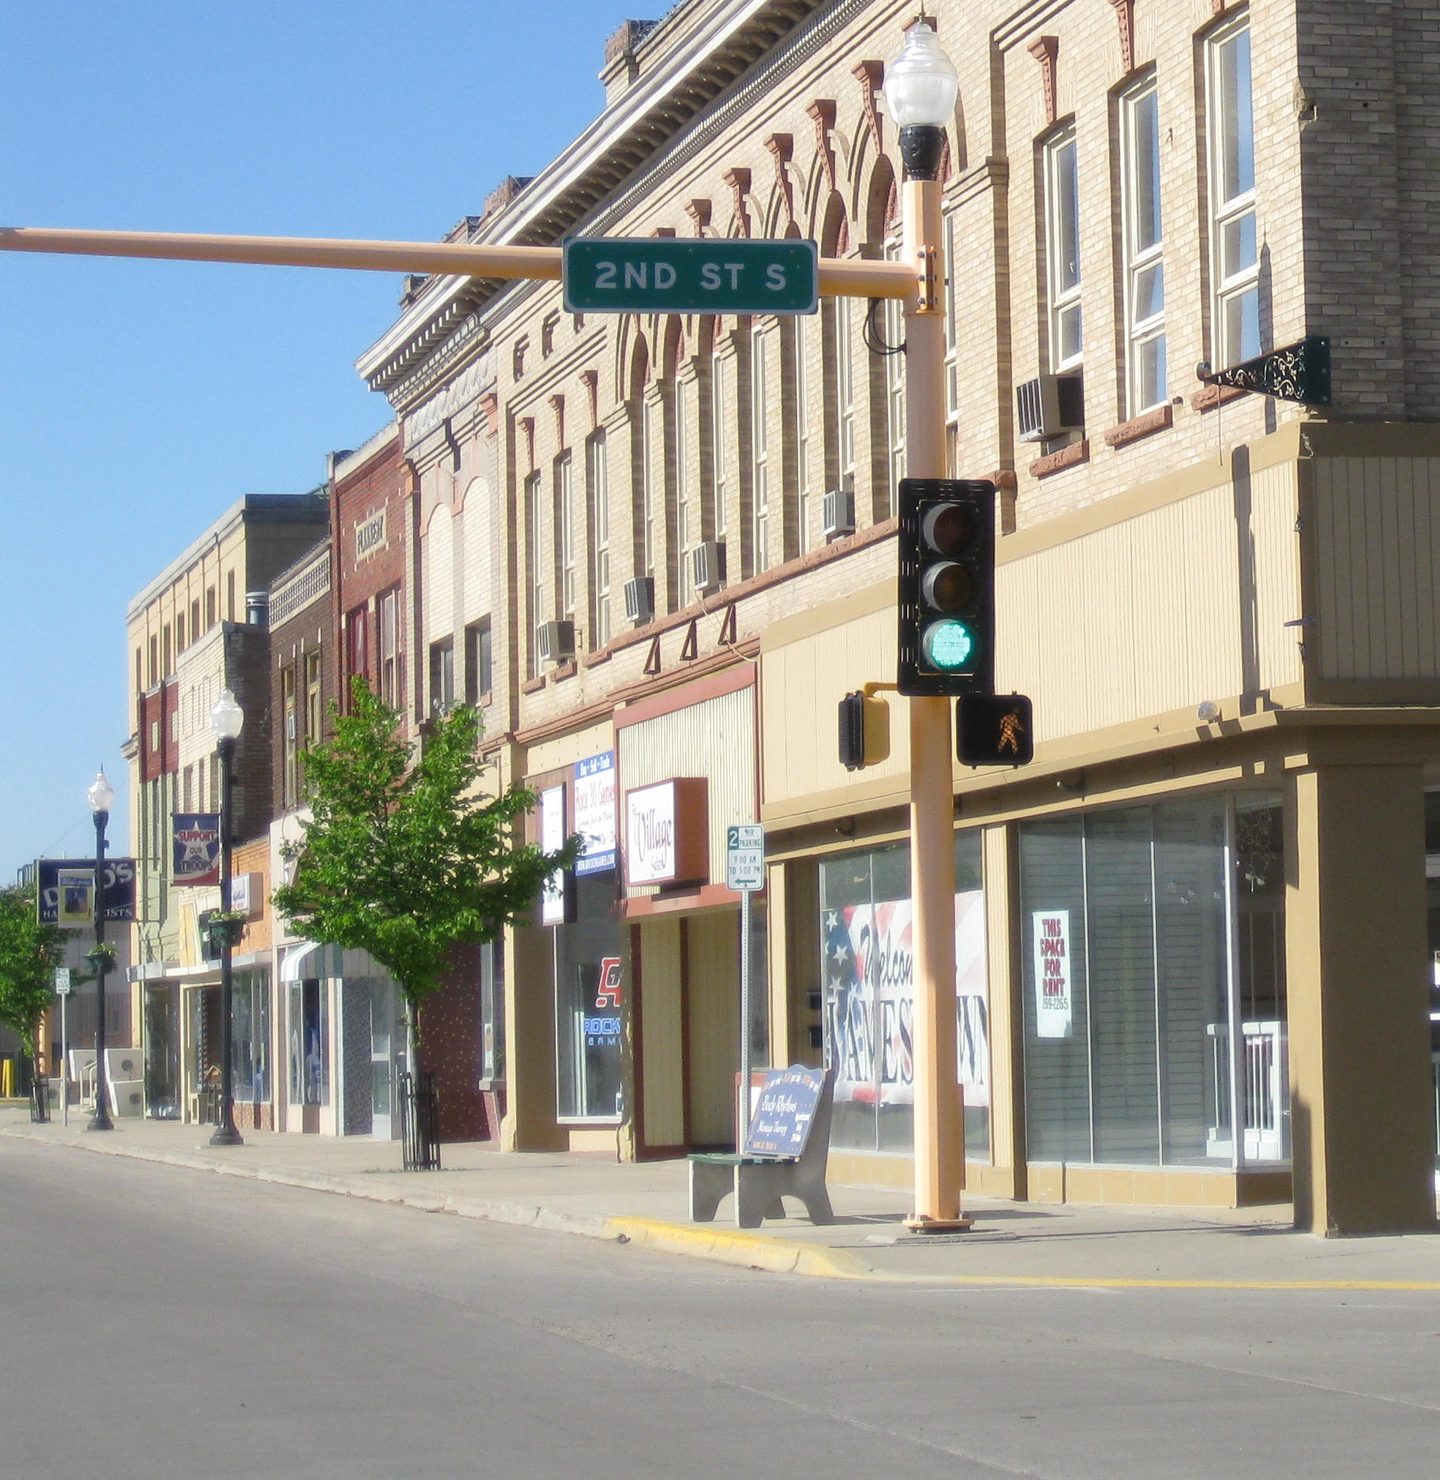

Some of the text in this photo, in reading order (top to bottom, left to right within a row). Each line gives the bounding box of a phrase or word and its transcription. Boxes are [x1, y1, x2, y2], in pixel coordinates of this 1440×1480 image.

[594, 261, 787, 291] 2ND ST S
[178, 830, 215, 842] SUPPORT
[633, 807, 672, 870] Village
[729, 830, 738, 847] 2
[189, 846, 203, 855] OUR
[181, 859, 213, 872] TROOPS
[1041, 918, 1062, 938] THIS
[859, 923, 913, 988] Welco
[1039, 938, 1066, 958] SPACE
[1043, 958, 1062, 978] FOR
[1042, 978, 1066, 997] RENT
[584, 1017, 621, 1035] ROCK
[587, 1036, 621, 1046] GAM
[822, 996, 989, 1086] JAMESWN
